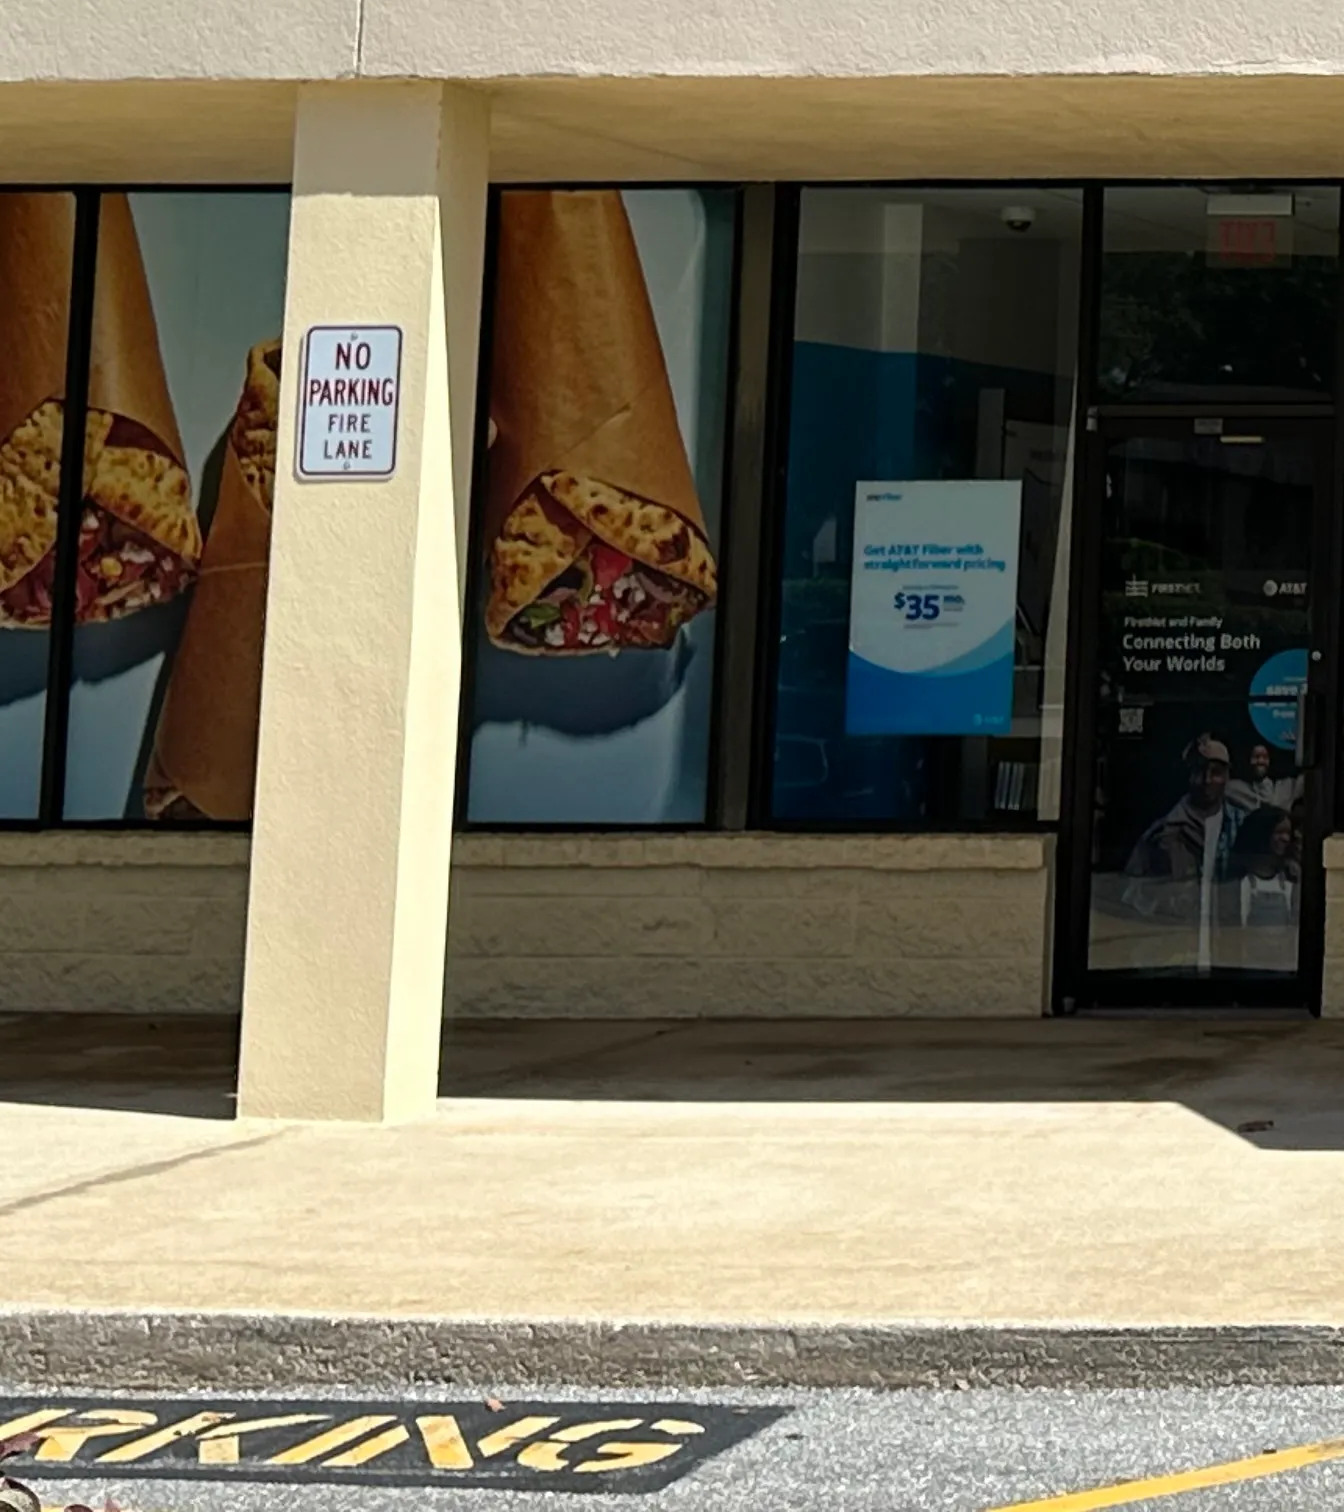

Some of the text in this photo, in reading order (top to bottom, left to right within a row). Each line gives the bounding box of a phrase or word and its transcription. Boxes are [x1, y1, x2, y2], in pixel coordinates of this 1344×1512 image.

[335, 341, 372, 370] NO
[308, 377, 394, 406] PARKING
[327, 413, 372, 433] FIRE
[323, 439, 373, 460] LANE
[864, 544, 886, 556] Get
[894, 592, 940, 620] $35
[1122, 632, 1261, 653] Connecting Both
[1123, 655, 1226, 672] Your Worlds
